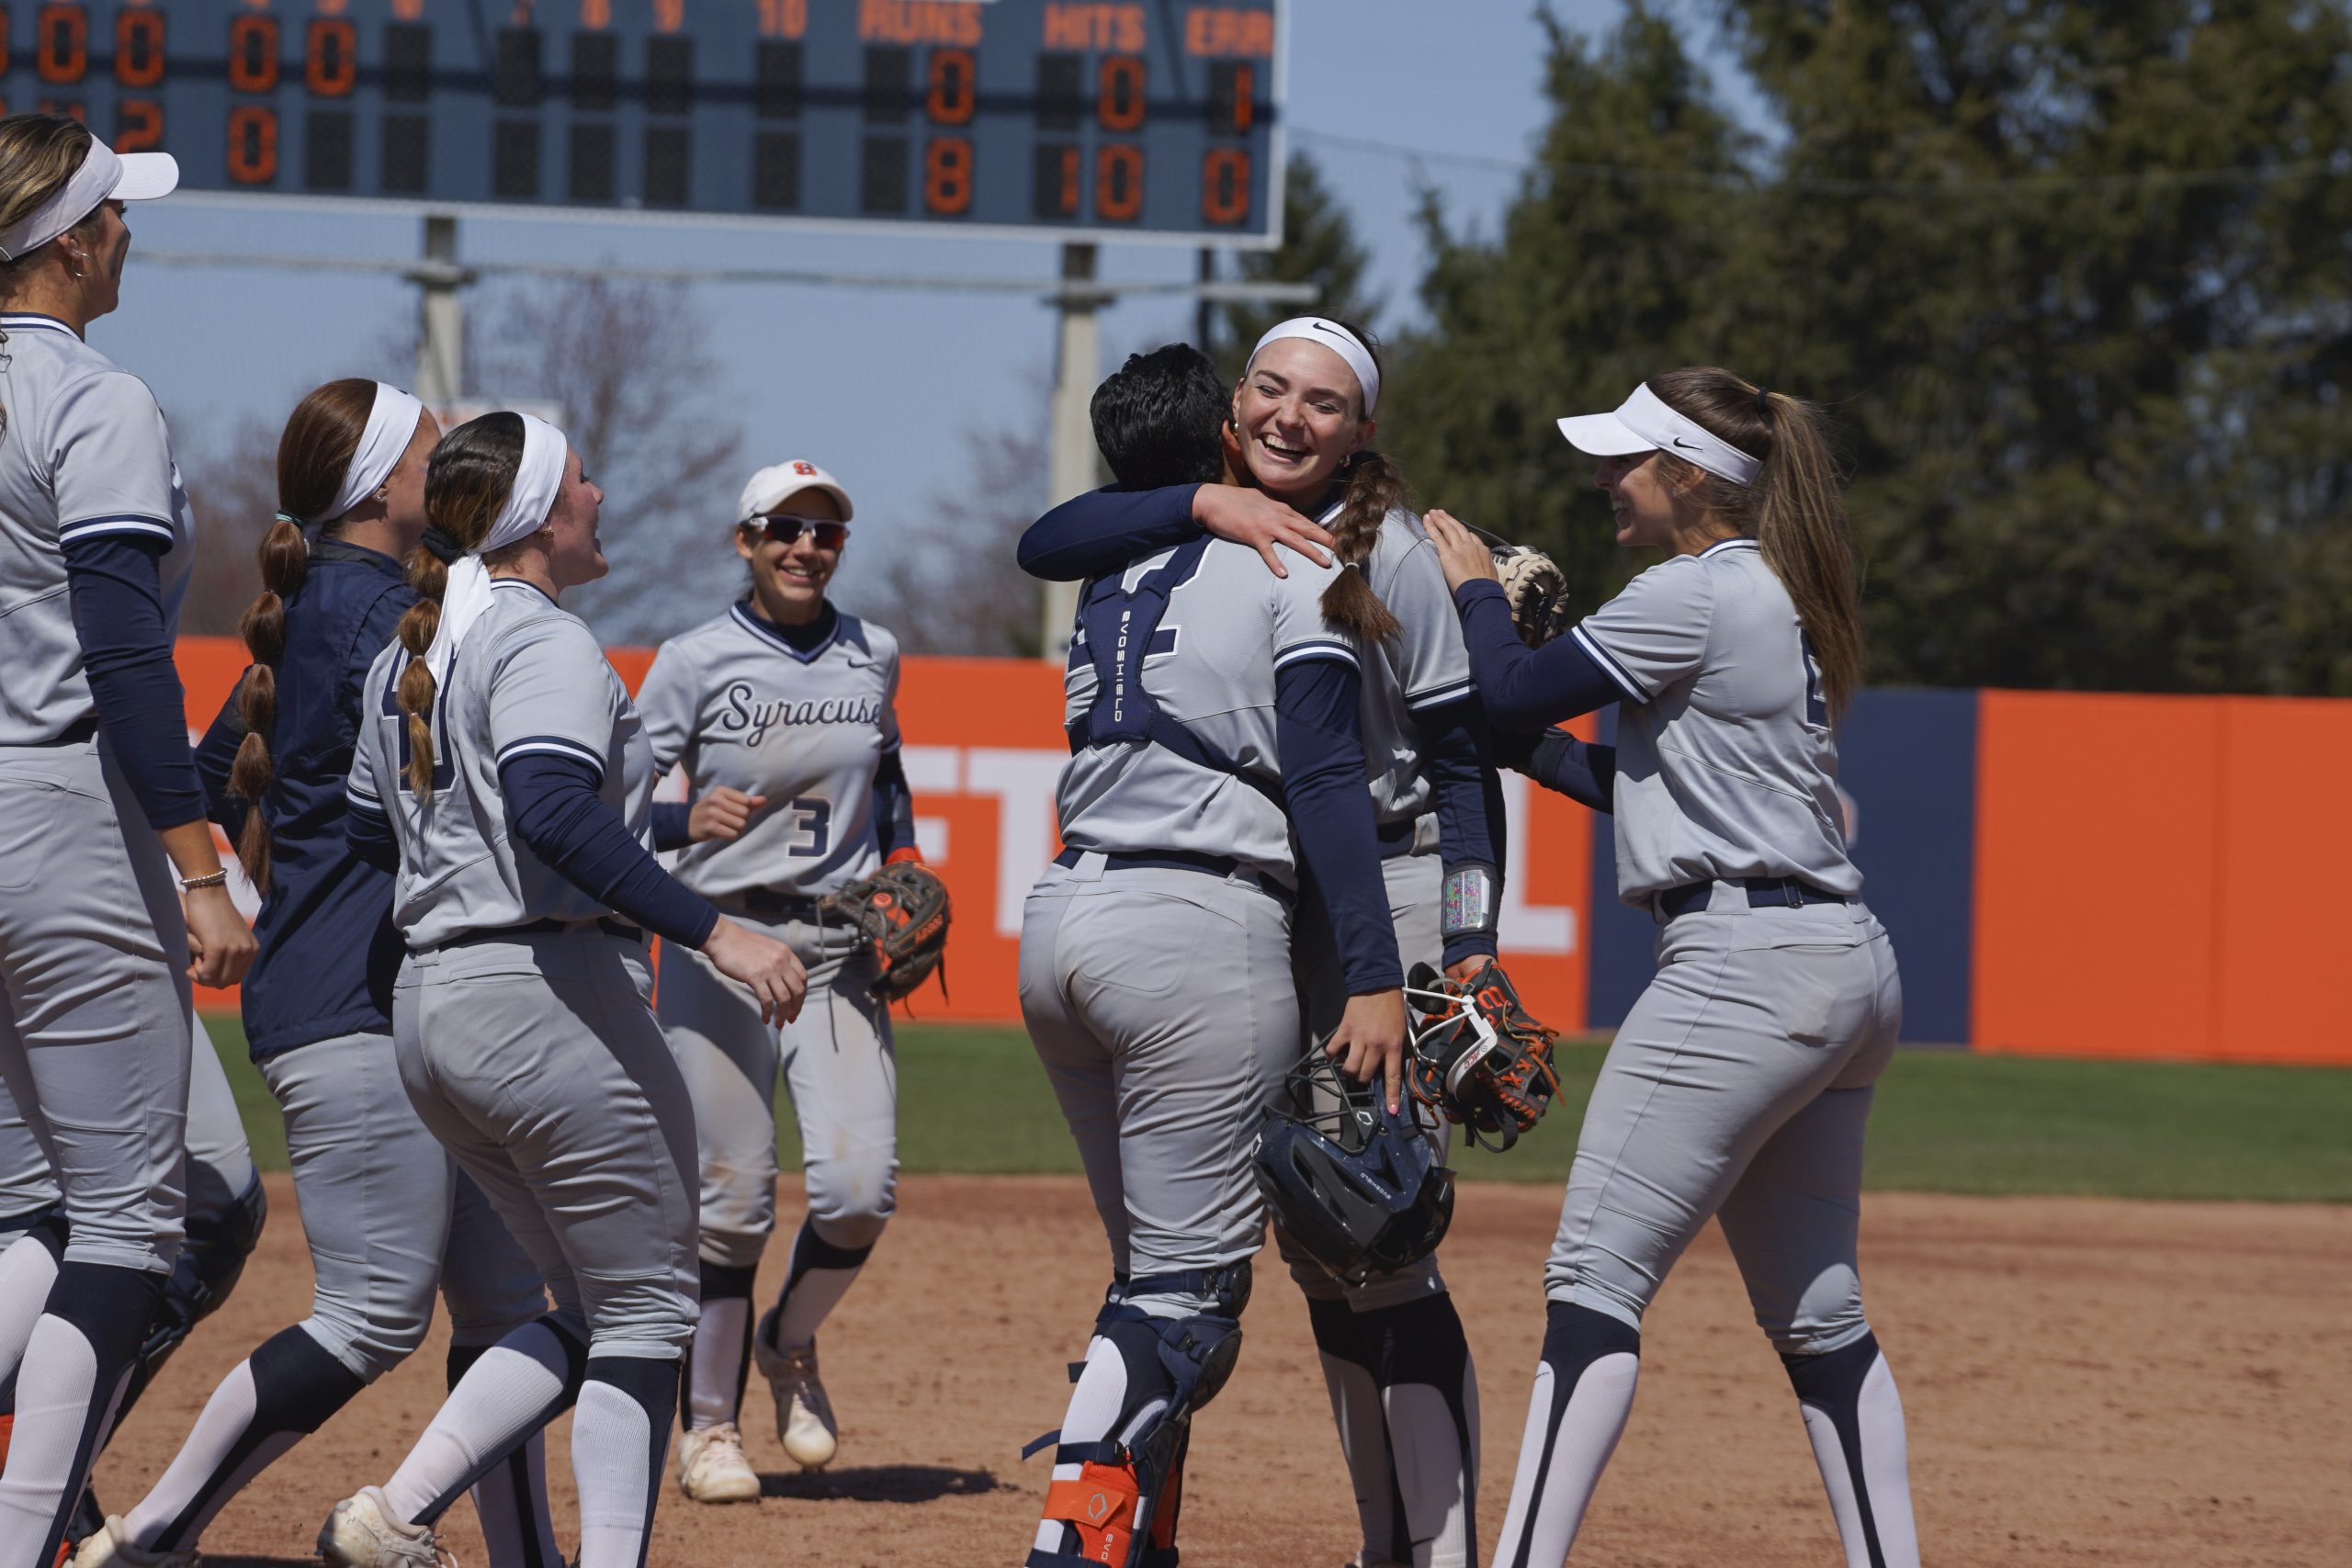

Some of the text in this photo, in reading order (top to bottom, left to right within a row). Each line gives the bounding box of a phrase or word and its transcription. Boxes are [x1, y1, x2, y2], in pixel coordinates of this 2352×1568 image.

[38, 5, 87, 85] 0
[115, 8, 165, 87] 0
[229, 15, 279, 94] 0
[305, 18, 356, 96] 0
[927, 50, 975, 126] 0
[1097, 56, 1146, 131] 0
[1233, 65, 1253, 130] 1
[856, 2, 982, 45] RUNS
[1043, 6, 1146, 52] HITS
[227, 106, 277, 183] 0
[924, 138, 973, 214] 8
[1202, 149, 1250, 223] 0
[1114, 610, 1132, 723] EVOSHIELD
[720, 679, 882, 750] Syracuse
[786, 795, 832, 859] 3
